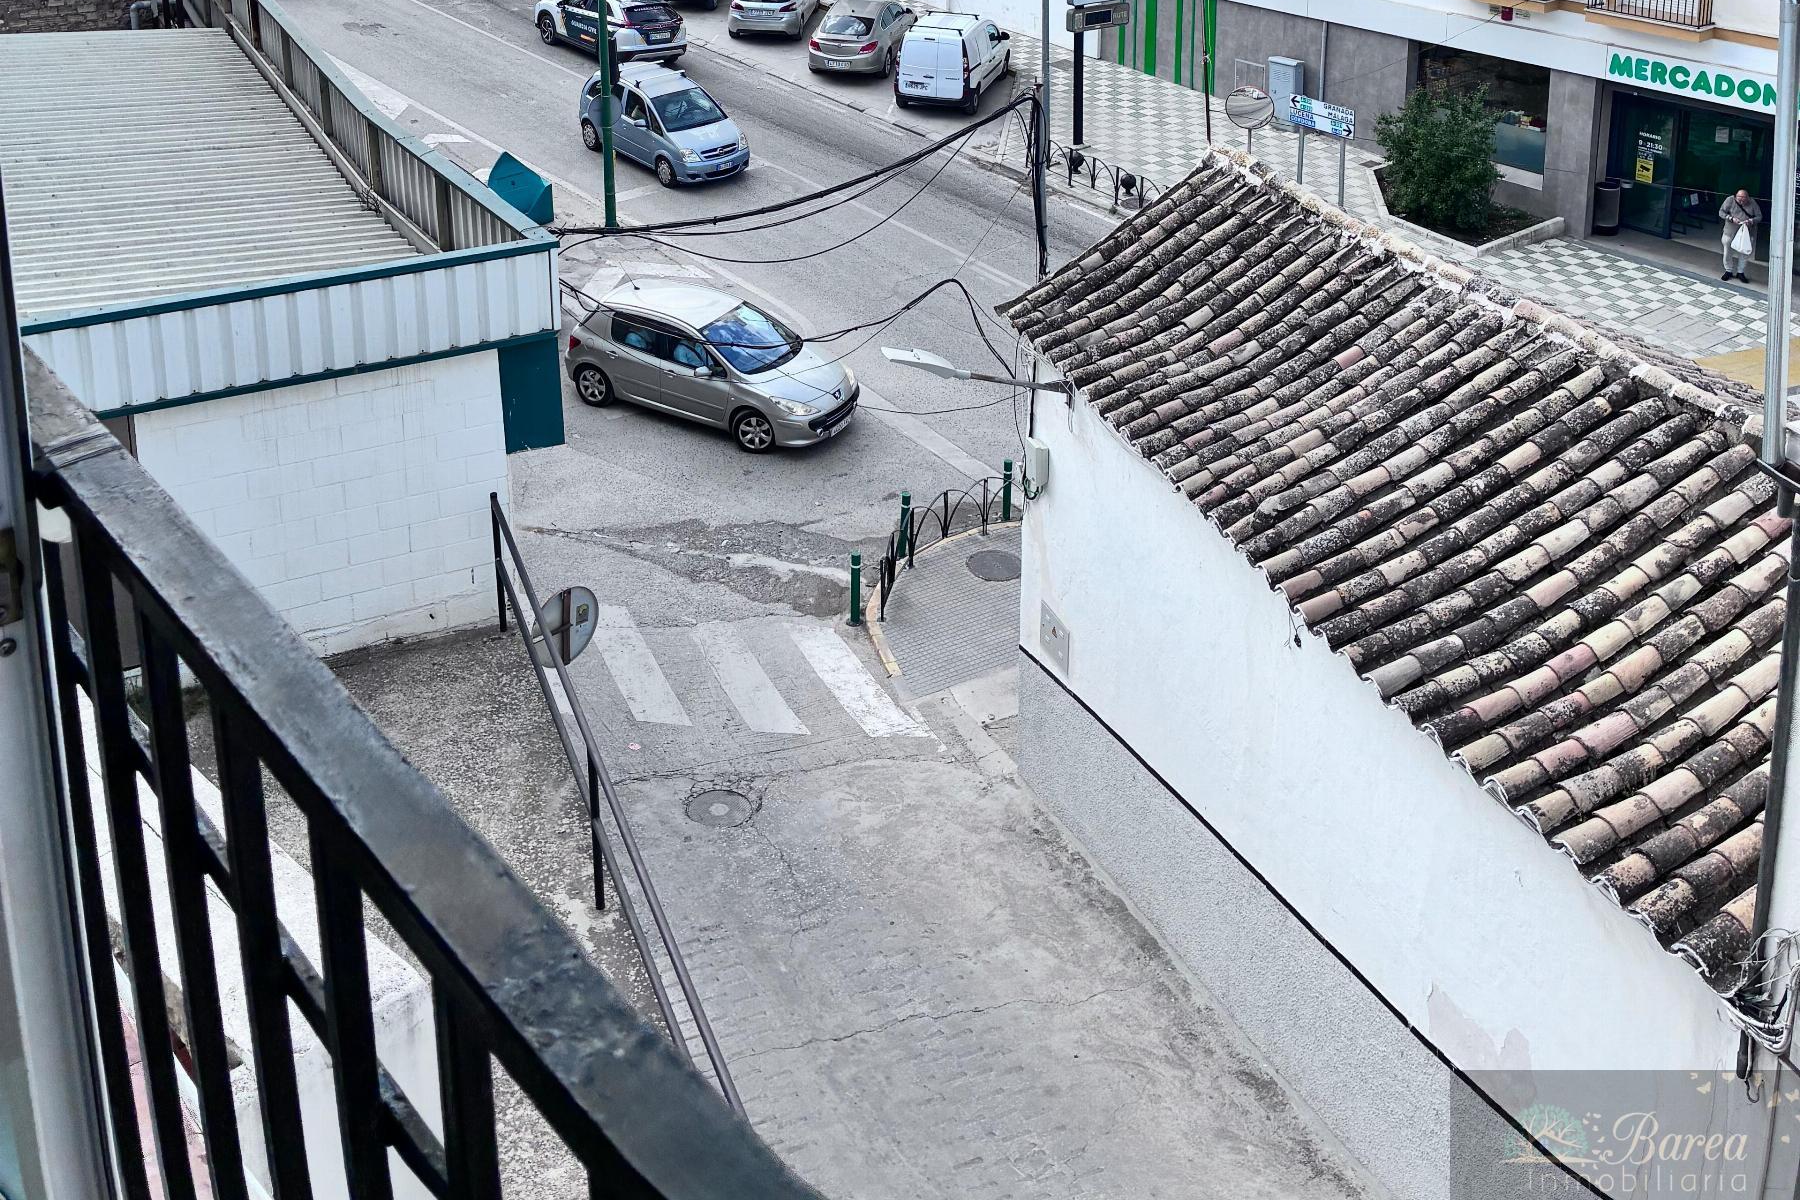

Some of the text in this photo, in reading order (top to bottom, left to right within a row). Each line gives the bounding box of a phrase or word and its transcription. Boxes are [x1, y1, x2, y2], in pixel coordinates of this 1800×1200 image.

[1609, 53, 1777, 107] MERCADON
[1290, 108, 1314, 120] LUCENA
[1323, 103, 1353, 116] GRANADA
